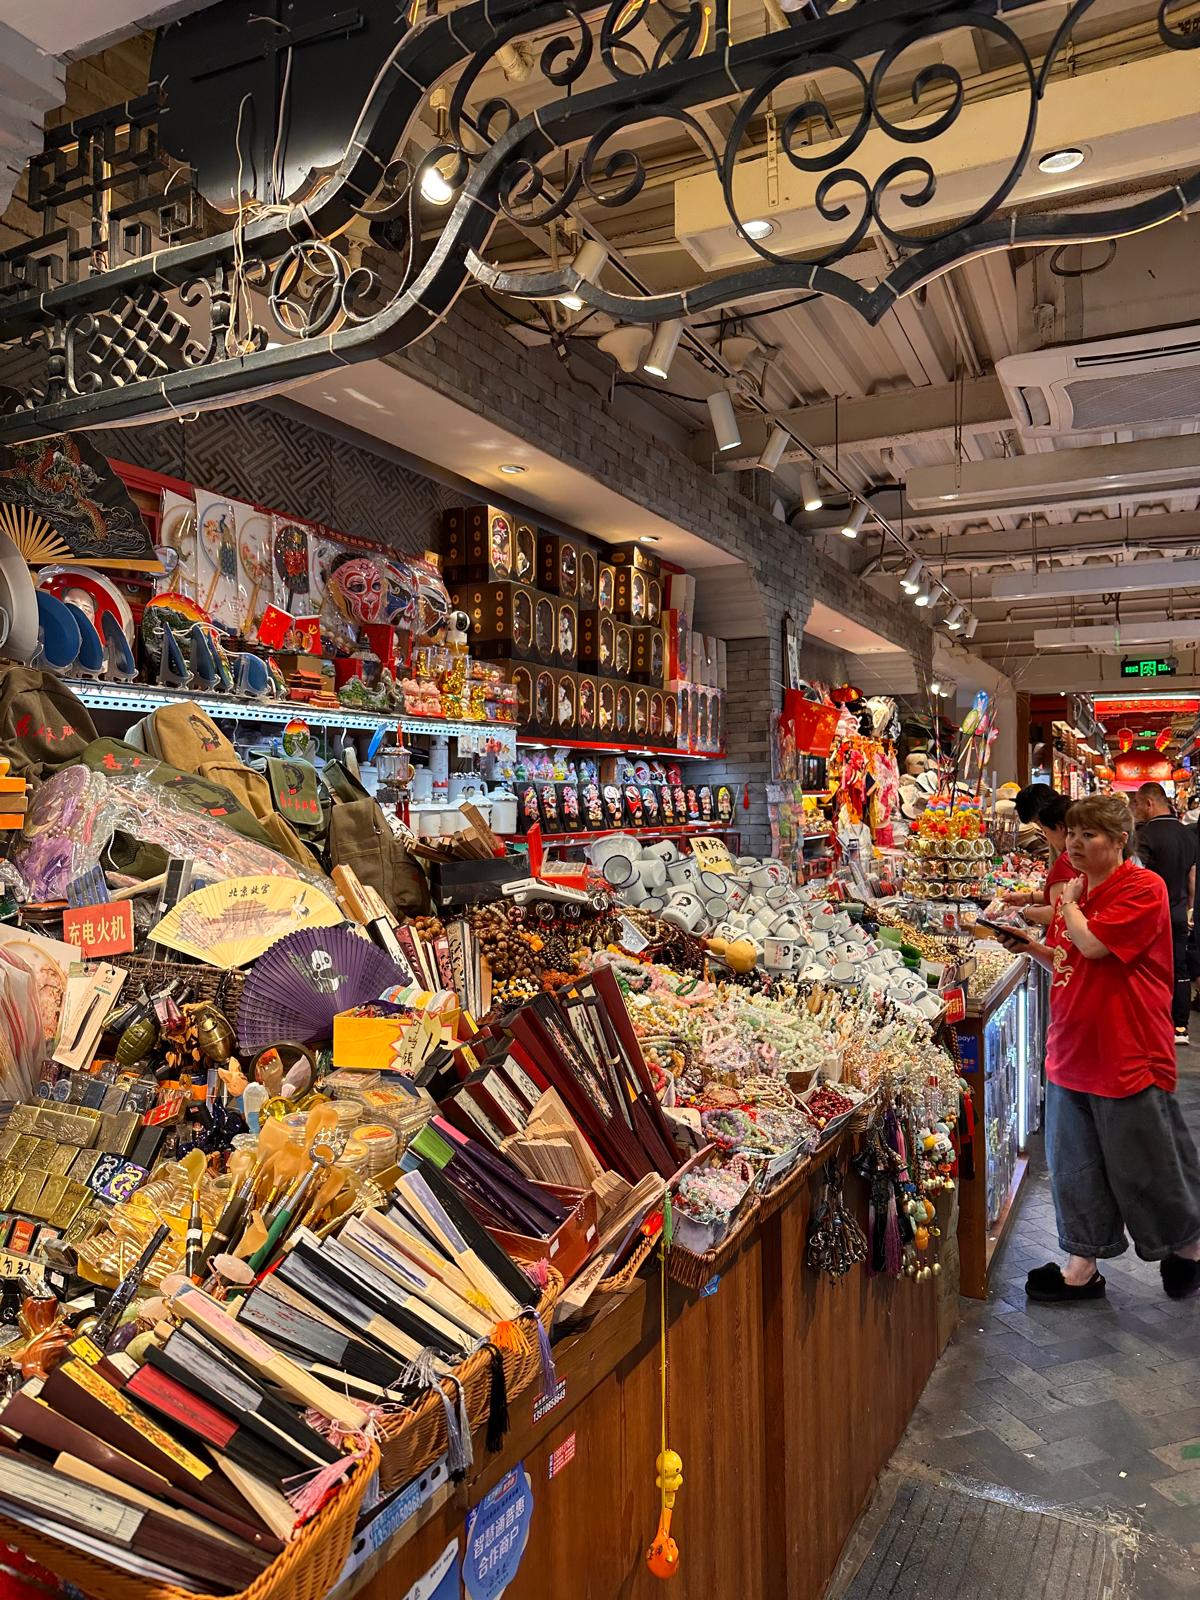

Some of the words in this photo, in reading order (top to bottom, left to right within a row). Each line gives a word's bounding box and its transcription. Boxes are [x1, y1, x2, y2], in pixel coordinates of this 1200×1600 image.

[228, 884, 271, 898] 北京故宫
[68, 915, 127, 945] 充电火机
[478, 1524, 519, 1580] 合作商户
